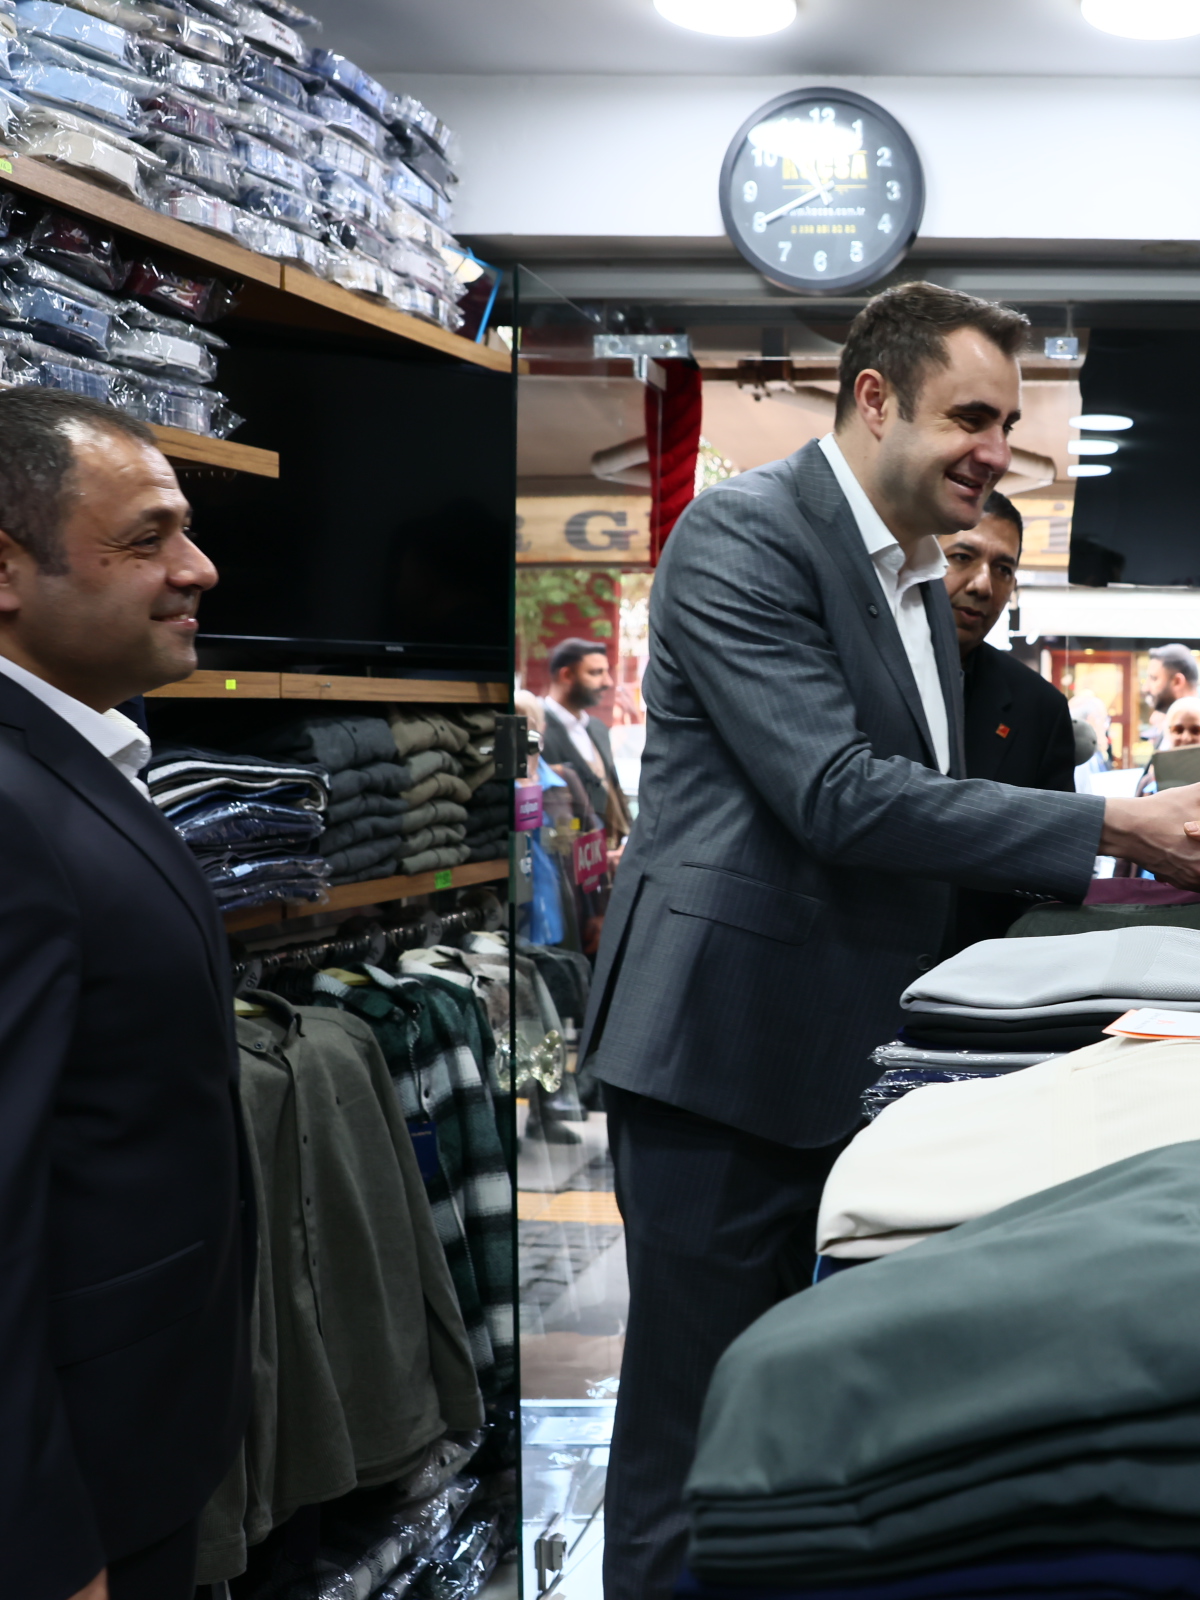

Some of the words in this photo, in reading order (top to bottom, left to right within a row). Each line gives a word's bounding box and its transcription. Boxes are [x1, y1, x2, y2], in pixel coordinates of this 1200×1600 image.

[809, 107, 835, 127] 12
[876, 147, 892, 167] 2
[743, 180, 758, 202] 9
[886, 180, 901, 201] 3
[753, 212, 767, 233] 8
[877, 213, 892, 233] 4
[778, 241, 792, 262] 7
[813, 250, 828, 272] 6
[850, 240, 864, 262] 5
